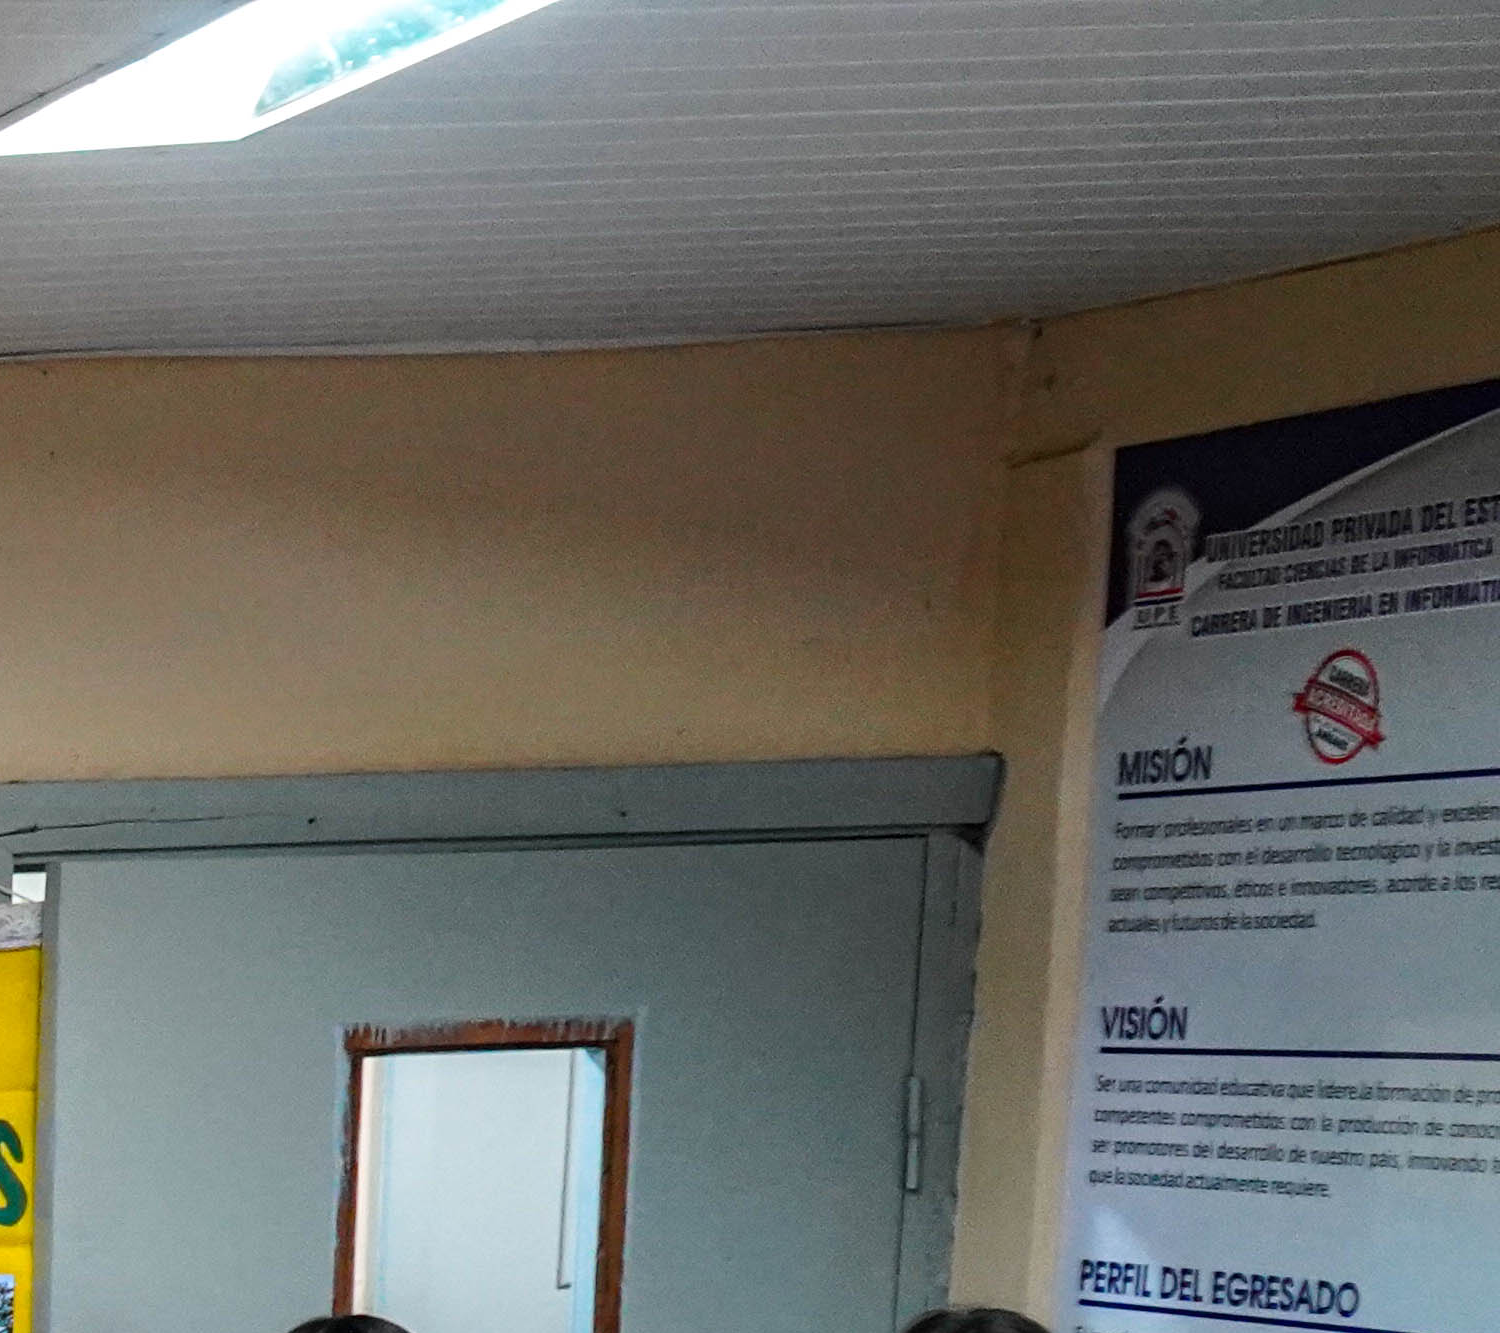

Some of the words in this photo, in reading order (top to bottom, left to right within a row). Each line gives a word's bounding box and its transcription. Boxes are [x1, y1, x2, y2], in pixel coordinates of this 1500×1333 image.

[1205, 521, 1325, 563] UNIVERSIDAD
[1332, 506, 1413, 543] PRIVADA
[1419, 500, 1456, 533] DEL
[1262, 605, 1283, 629] DE
[1117, 737, 1212, 787] MISIÓN
[1101, 996, 1188, 1041] VISIÓN
[1146, 1077, 1218, 1095] comunidad
[1290, 1116, 1316, 1131] con
[1079, 1259, 1151, 1298] PERFIL
[1161, 1265, 1203, 1303] DEL
[1211, 1271, 1360, 1318] EGRESADO
